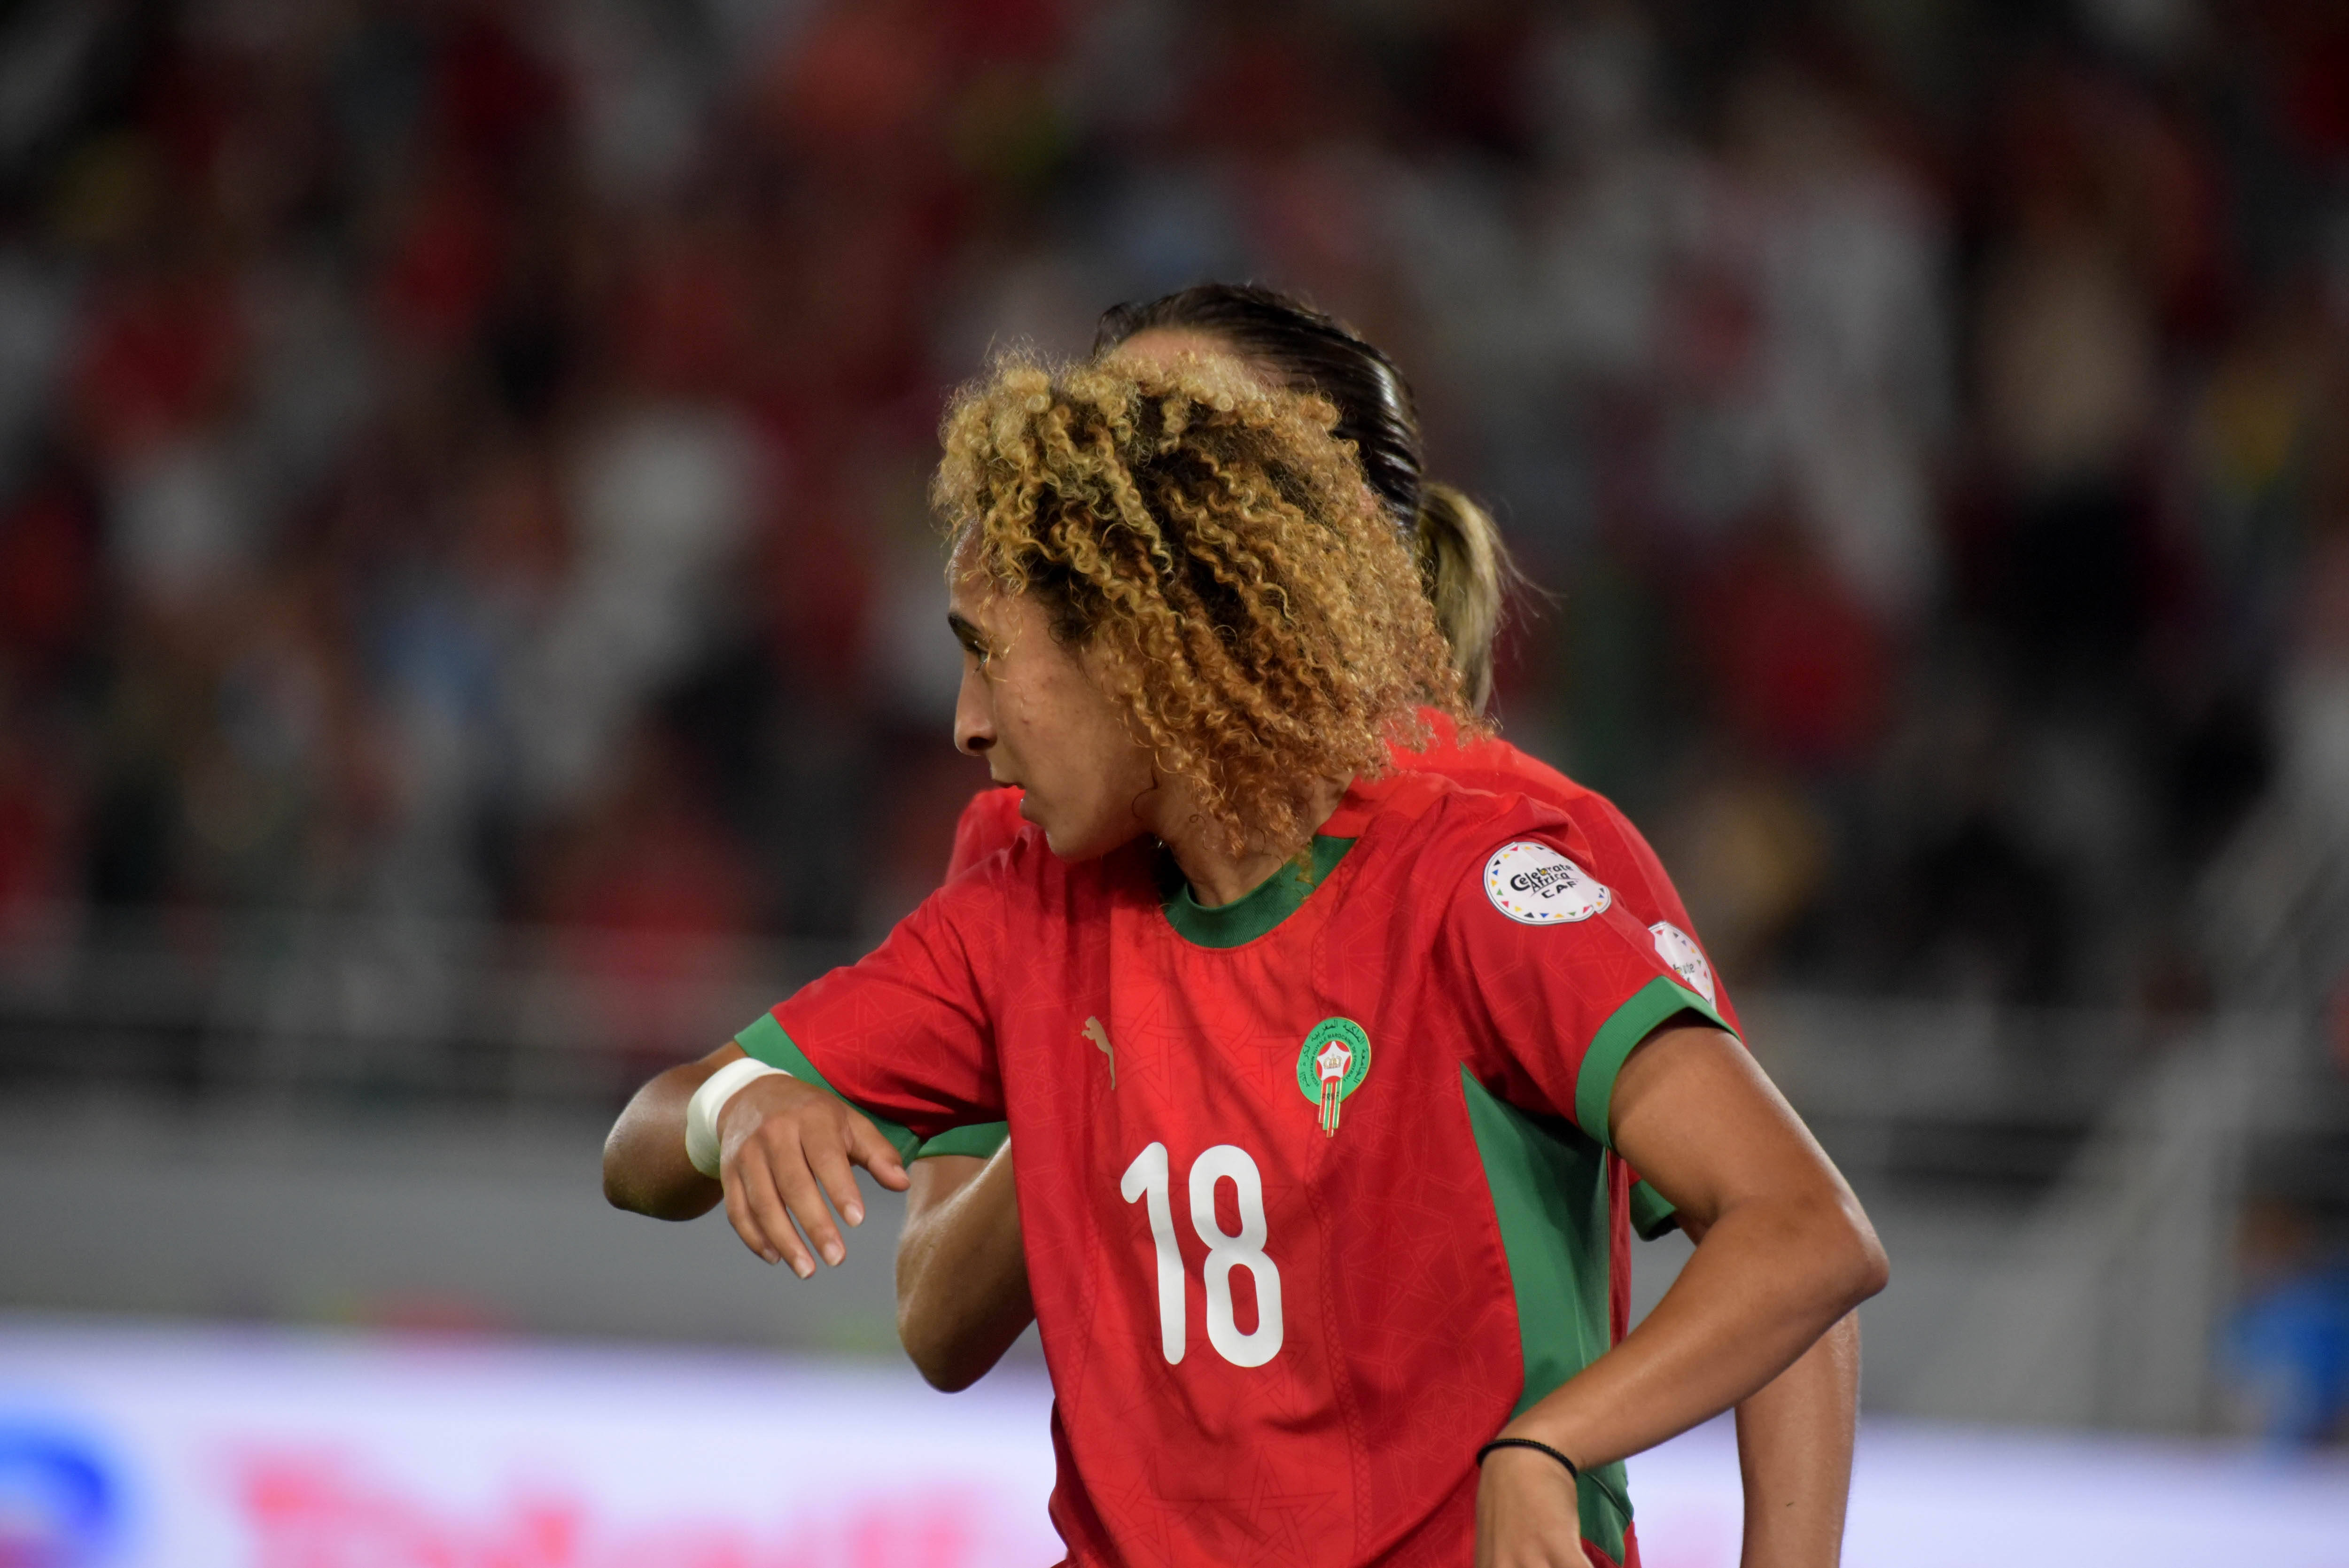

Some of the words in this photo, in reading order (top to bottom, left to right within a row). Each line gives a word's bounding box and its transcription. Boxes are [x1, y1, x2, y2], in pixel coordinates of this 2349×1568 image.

[1510, 863, 1574, 891] Celebrate
[1531, 872, 1571, 894] Africa
[1541, 880, 1577, 898] CAF
[1120, 1141, 1283, 1367] 18
